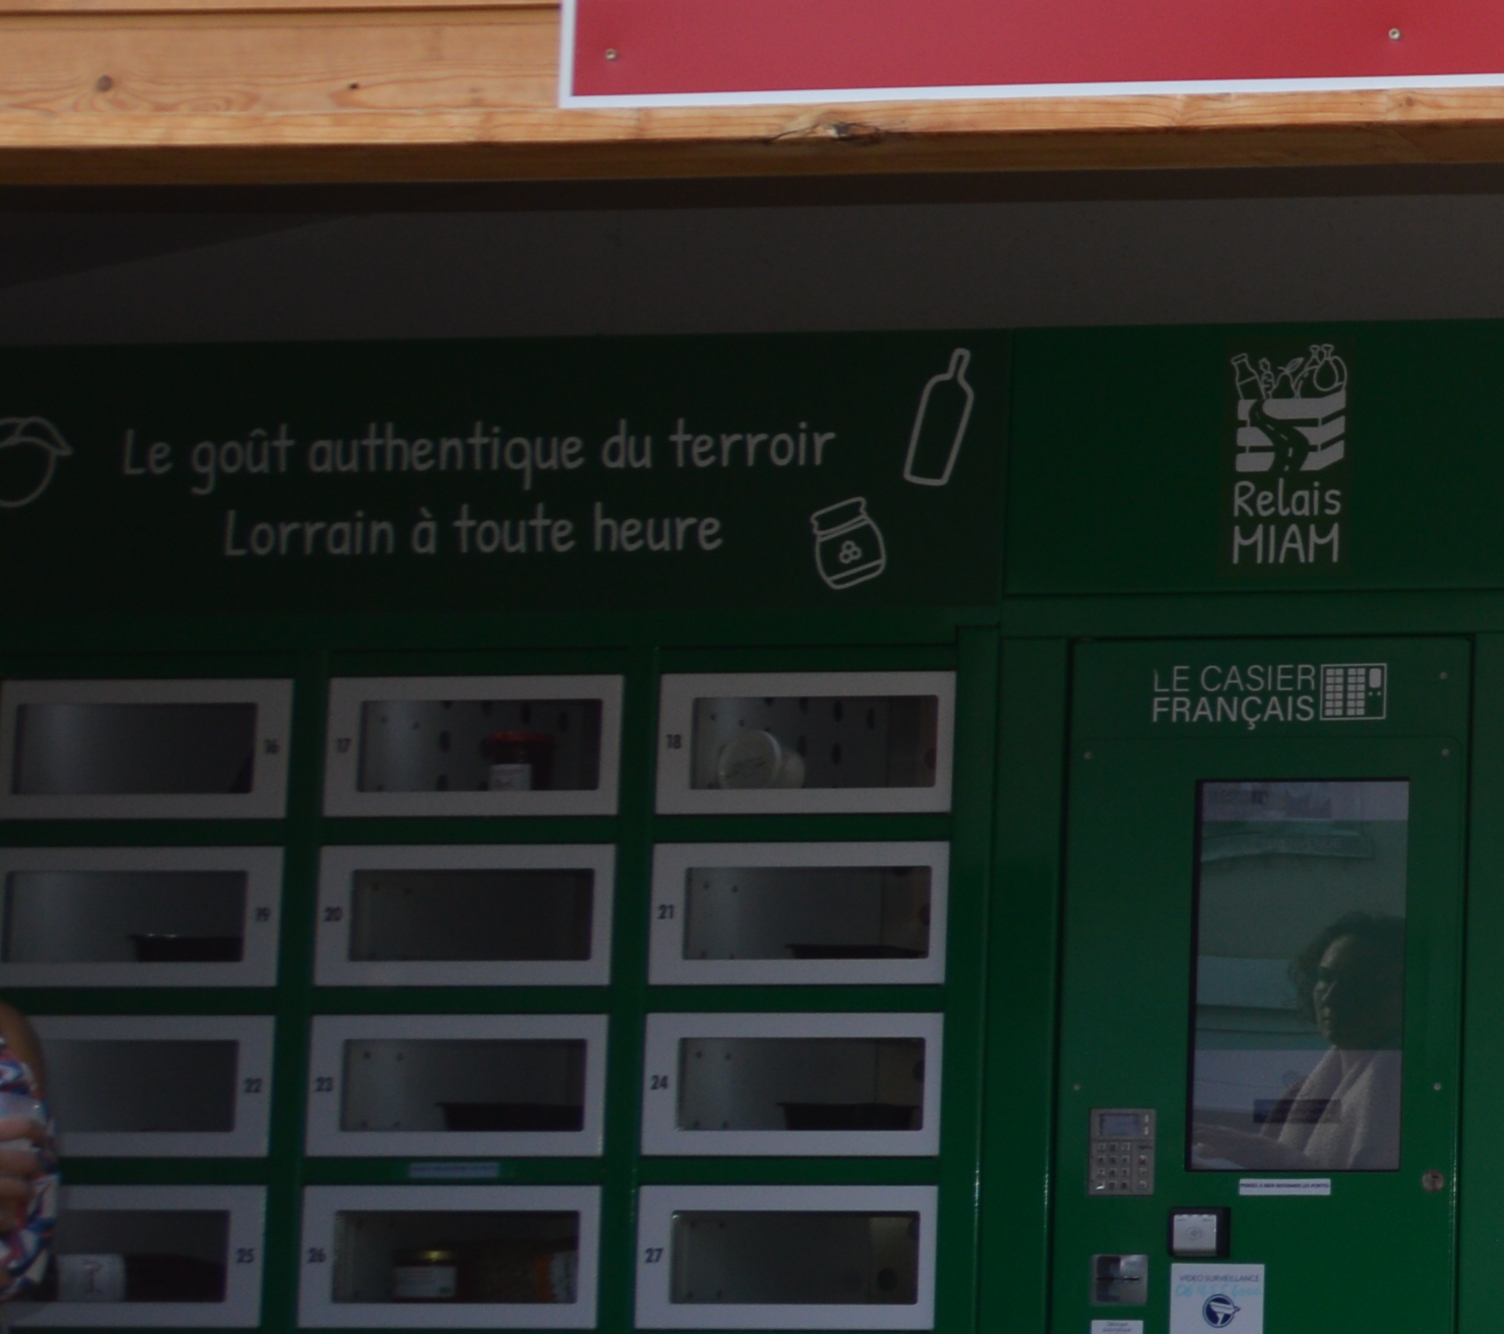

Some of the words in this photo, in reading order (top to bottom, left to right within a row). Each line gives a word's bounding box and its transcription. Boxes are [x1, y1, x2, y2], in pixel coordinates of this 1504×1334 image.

[124, 430, 172, 474] Le
[192, 425, 295, 495] goût
[310, 422, 584, 490] authentique
[602, 419, 651, 468] du
[670, 419, 836, 467] terroir
[1234, 478, 1341, 516] Relais
[226, 510, 394, 555] Lorrain
[413, 508, 436, 553] à
[454, 503, 574, 552] toute
[595, 502, 722, 551] heure
[1233, 523, 1338, 564] MIAM
[1154, 666, 1189, 692] LE
[1201, 664, 1315, 691] CASIER
[1152, 697, 1316, 731] FRANÇAIS
[666, 733, 682, 750] 18
[255, 906, 271, 922] 19
[658, 903, 675, 920] 21
[244, 1077, 263, 1094] 22
[315, 1076, 334, 1093] 23
[650, 1074, 669, 1091] 24
[236, 1247, 255, 1264] 25
[307, 1247, 326, 1264] 26
[645, 1247, 664, 1264] 27
